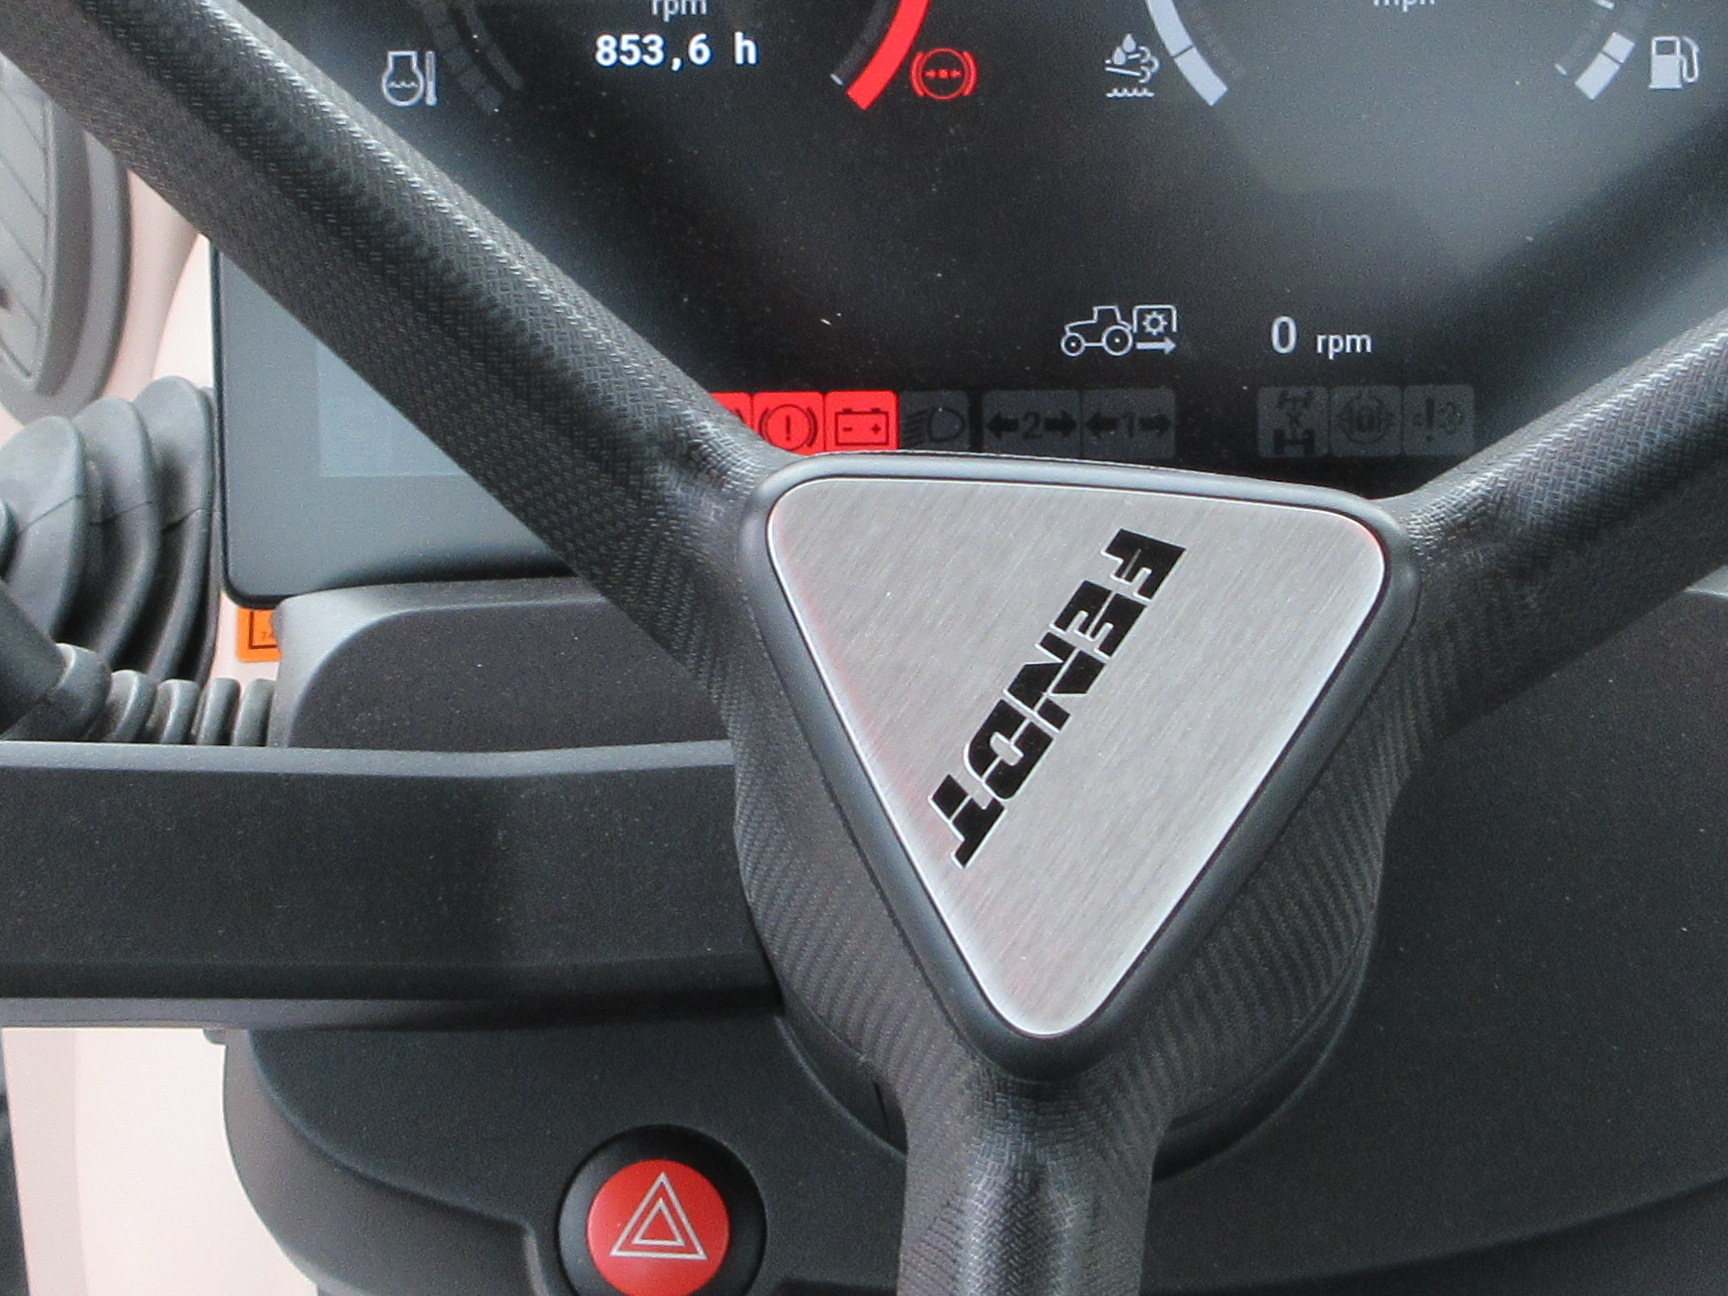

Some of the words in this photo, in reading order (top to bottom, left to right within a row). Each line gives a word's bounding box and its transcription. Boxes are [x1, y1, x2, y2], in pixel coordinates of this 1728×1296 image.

[595, 32, 712, 72] 853,6
[733, 30, 758, 65] h
[1271, 315, 1298, 354] 0
[1316, 334, 1372, 360] rpm
[927, 527, 1188, 870] FENDT
